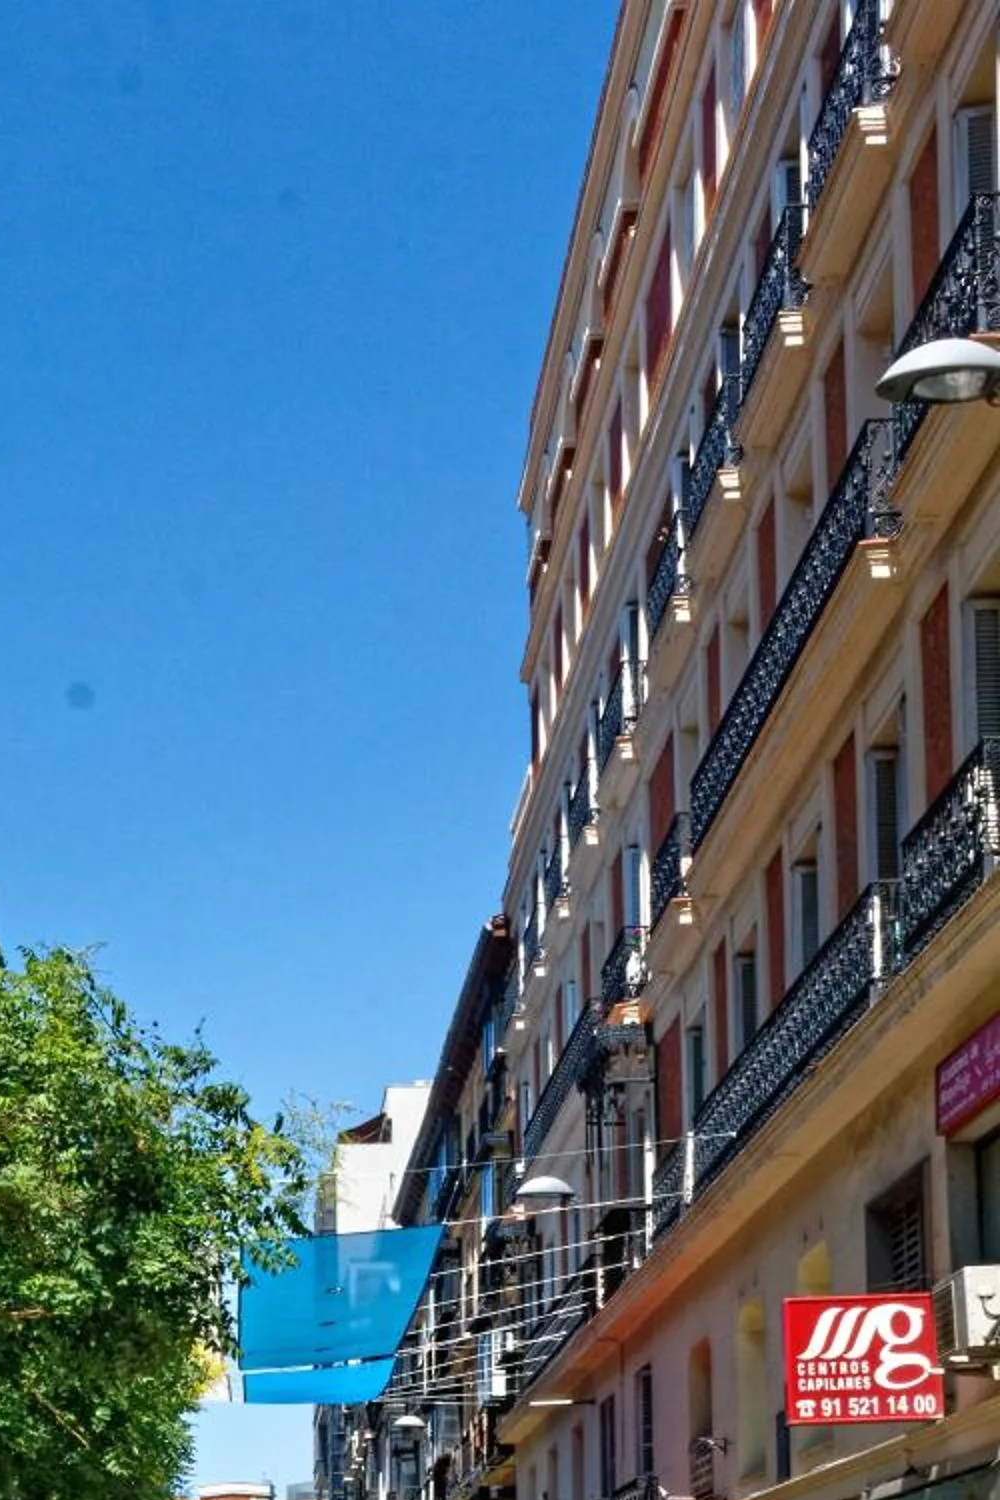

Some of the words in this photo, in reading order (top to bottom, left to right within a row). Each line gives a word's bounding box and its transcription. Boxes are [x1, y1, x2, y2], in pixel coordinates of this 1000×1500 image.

[797, 1361, 869, 1376] CENTROS
[797, 1376, 871, 1392] CAPILARES
[821, 1397, 841, 1417] 91
[848, 1395, 879, 1416] 521
[887, 1395, 909, 1414] 14
[913, 1394, 936, 1414] 00
